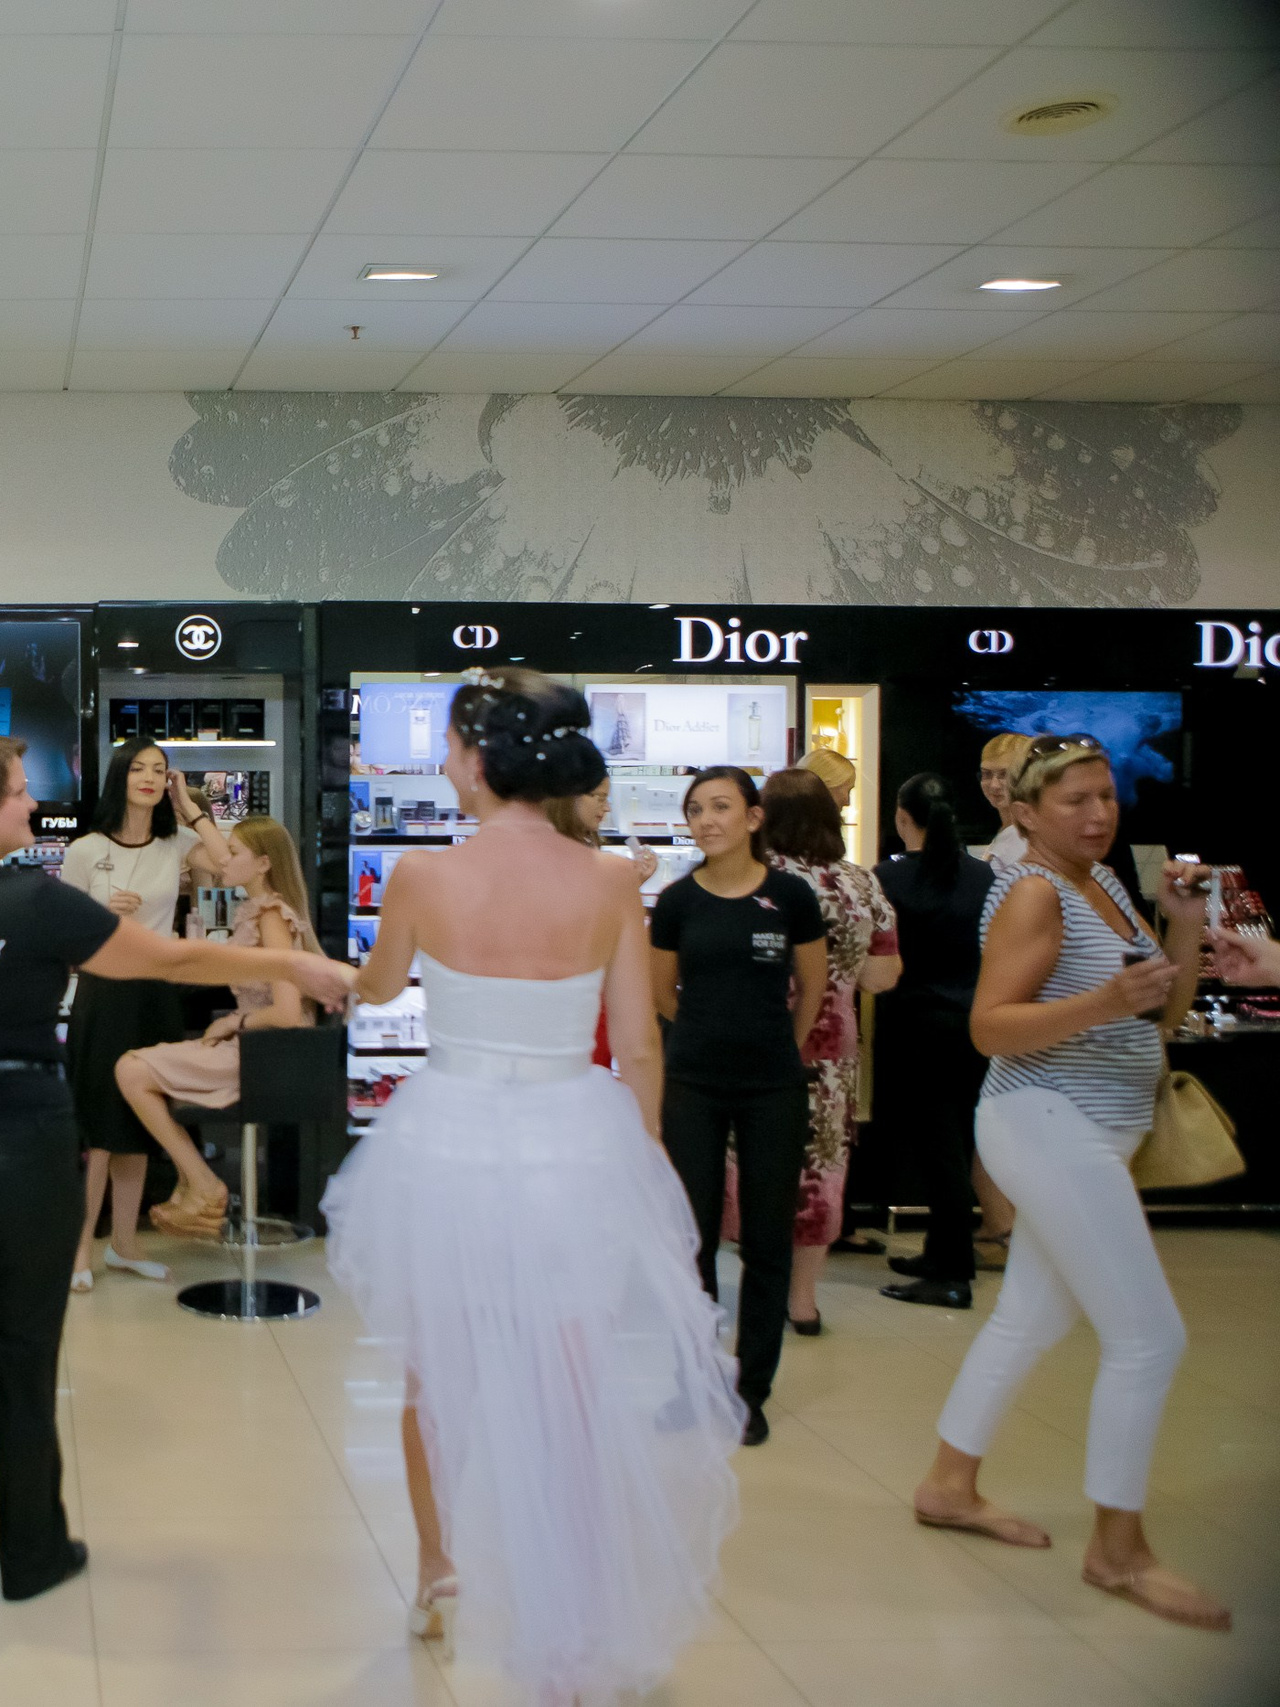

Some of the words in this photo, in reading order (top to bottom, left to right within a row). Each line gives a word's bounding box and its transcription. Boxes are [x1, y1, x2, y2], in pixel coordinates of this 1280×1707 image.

[673, 616, 808, 664] Dior
[654, 719, 680, 733] Dior
[683, 720, 719, 733] Addict
[41, 817, 78, 829] ГУБЫ
